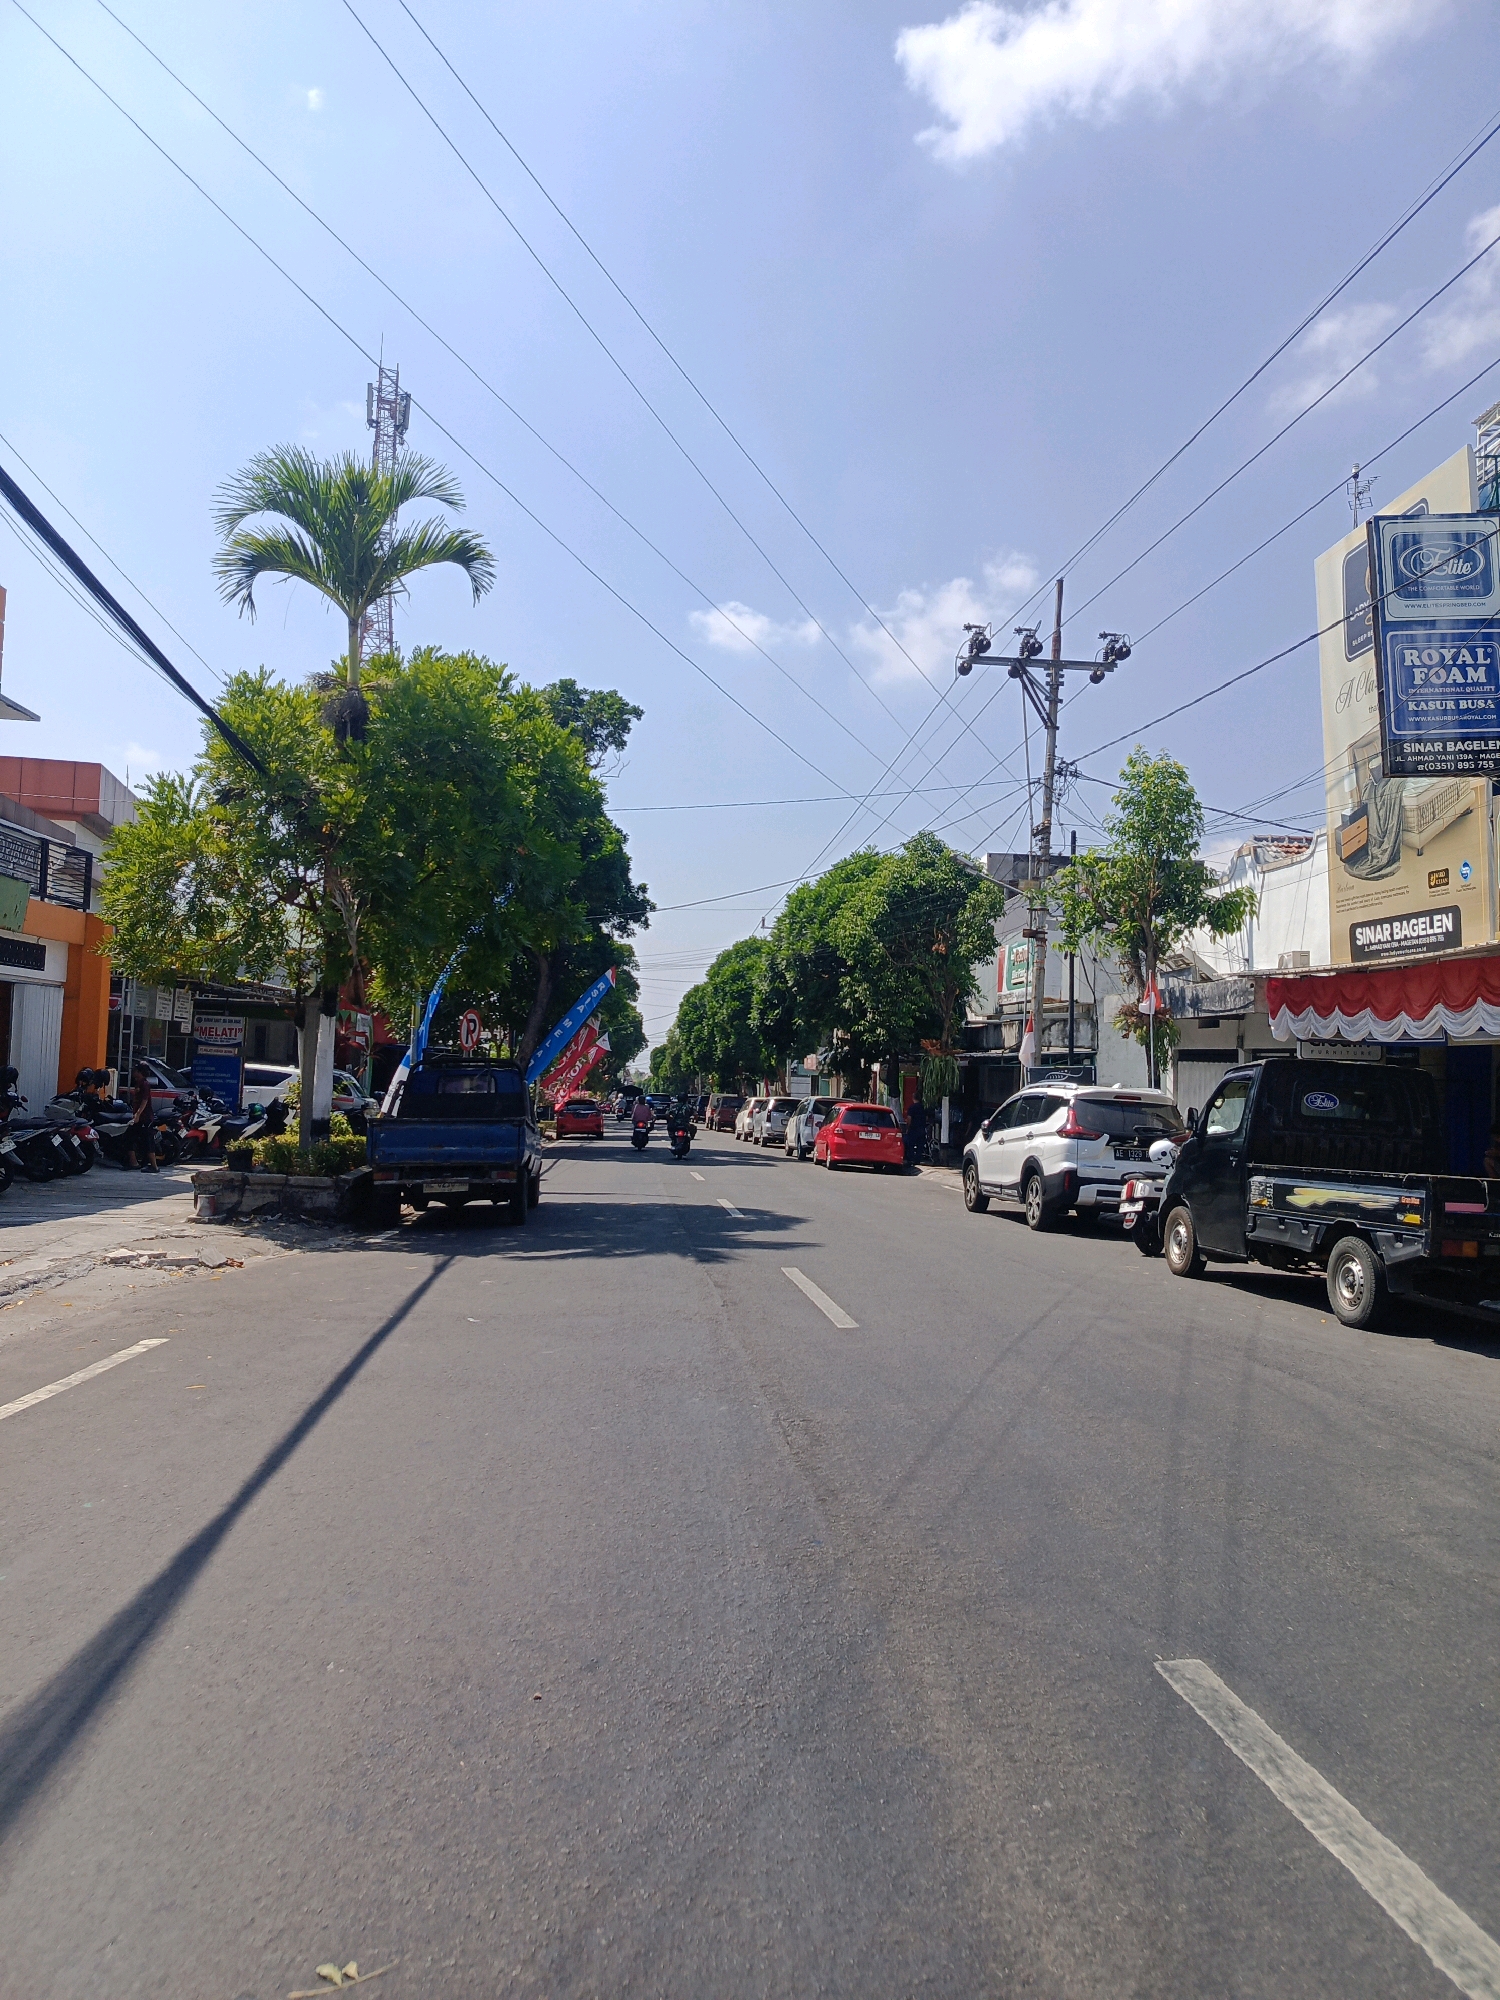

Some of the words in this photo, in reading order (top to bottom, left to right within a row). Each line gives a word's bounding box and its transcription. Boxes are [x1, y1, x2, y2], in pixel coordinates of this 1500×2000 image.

[1411, 547, 1472, 576] Elite
[1352, 633, 1367, 647] SLEEP
[1412, 666, 1487, 685] FOAM
[1408, 686, 1465, 694] INTERNATIONAL
[1465, 685, 1496, 693] QUALITY
[1407, 700, 1456, 711] KASUR
[1459, 699, 1495, 709] BUSA
[1403, 742, 1443, 753] SINAR
[1407, 754, 1435, 762] AHMAD
[1477, 760, 1495, 768] 755
[1355, 924, 1391, 946] SINAR
[1393, 912, 1453, 940] BAGELEN
[1115, 1149, 1124, 1158] AE
[1128, 1149, 1143, 1158] 1329
